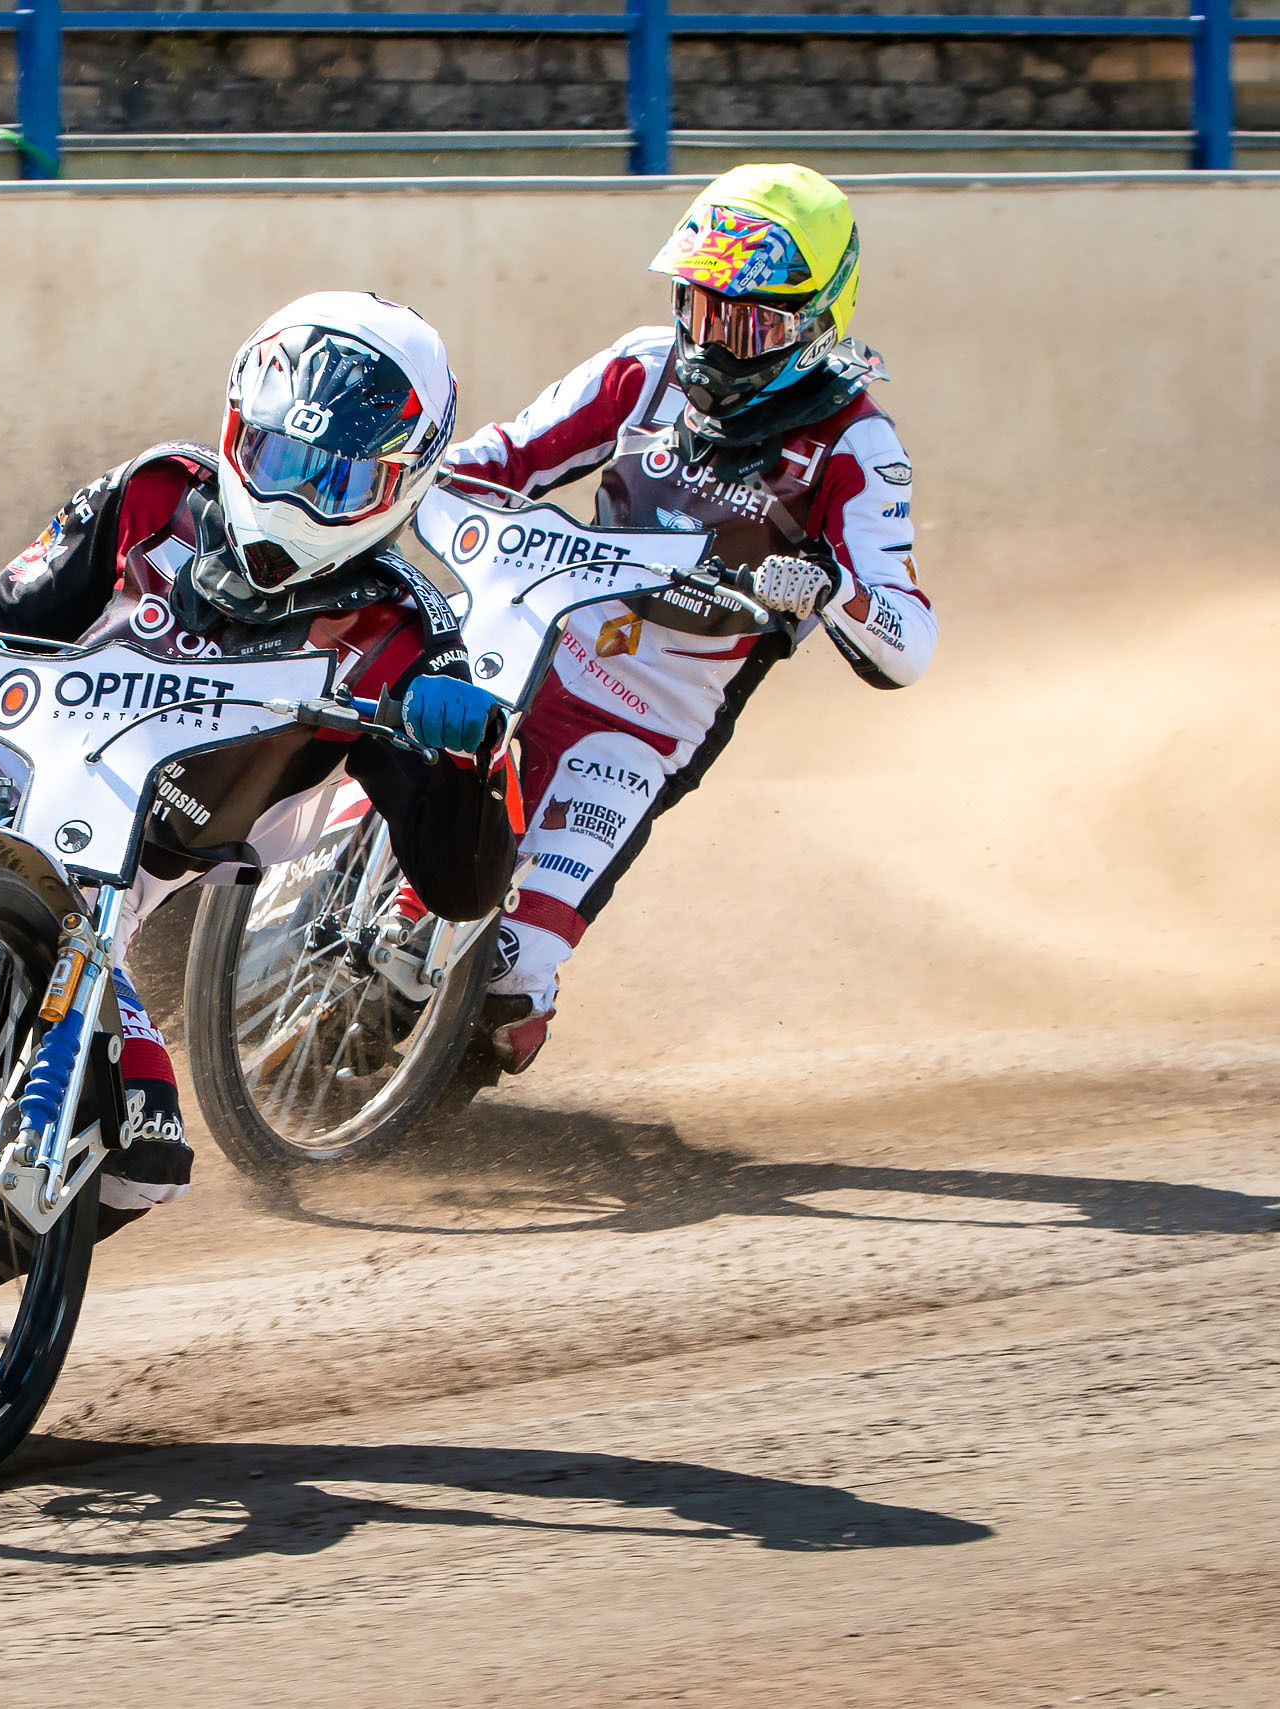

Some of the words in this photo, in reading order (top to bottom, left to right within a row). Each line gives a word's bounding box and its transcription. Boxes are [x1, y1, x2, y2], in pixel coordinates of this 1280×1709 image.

[497, 523, 631, 578] OPTIBET
[703, 604, 713, 618] 1
[55, 671, 234, 719] OPTIBET
[560, 631, 587, 664] BER
[584, 658, 650, 715] STUDIOS
[158, 775, 212, 827] ionship
[571, 799, 627, 830] YOGGY
[573, 813, 618, 842] BEAR
